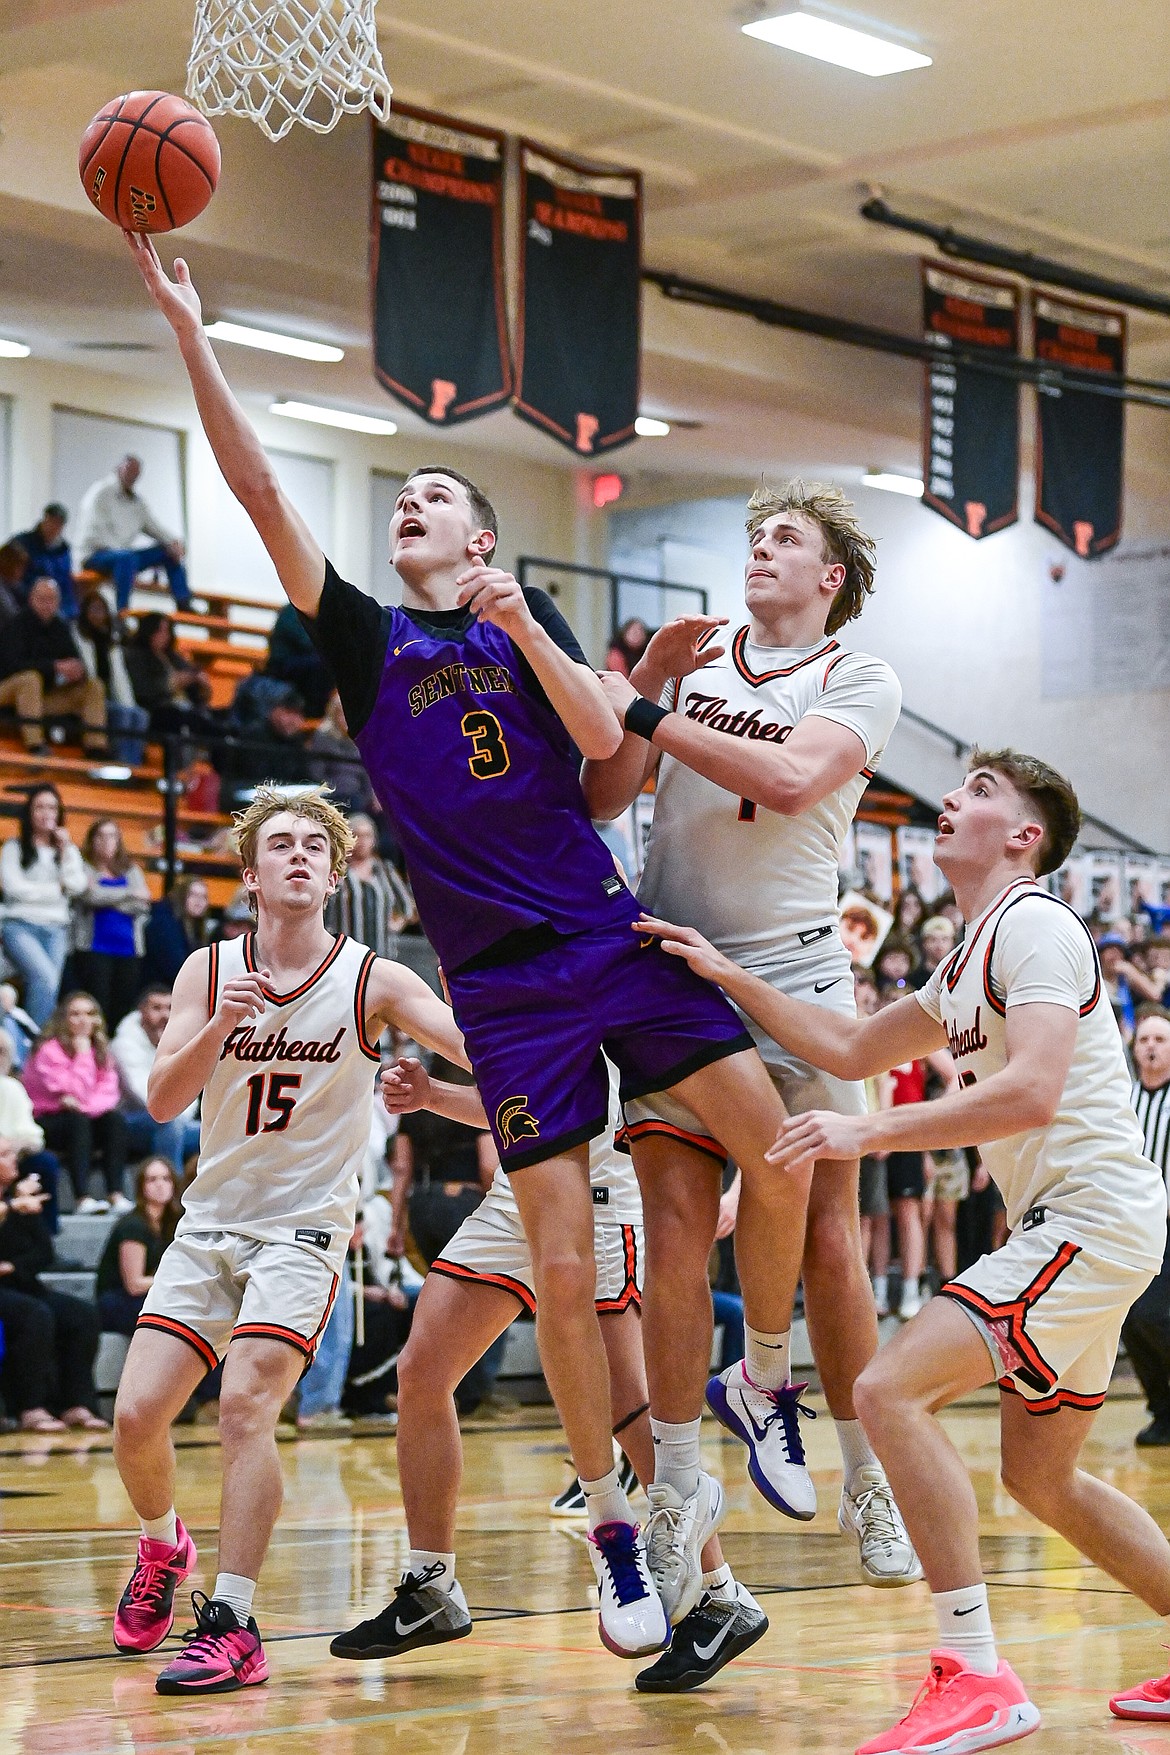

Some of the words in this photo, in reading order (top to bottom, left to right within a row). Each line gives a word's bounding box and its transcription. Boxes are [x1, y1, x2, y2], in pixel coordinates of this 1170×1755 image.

[460, 709, 511, 781] 3
[684, 692, 795, 745] Flathea
[219, 1025, 347, 1064] Flathead
[244, 1072, 303, 1137] 15
